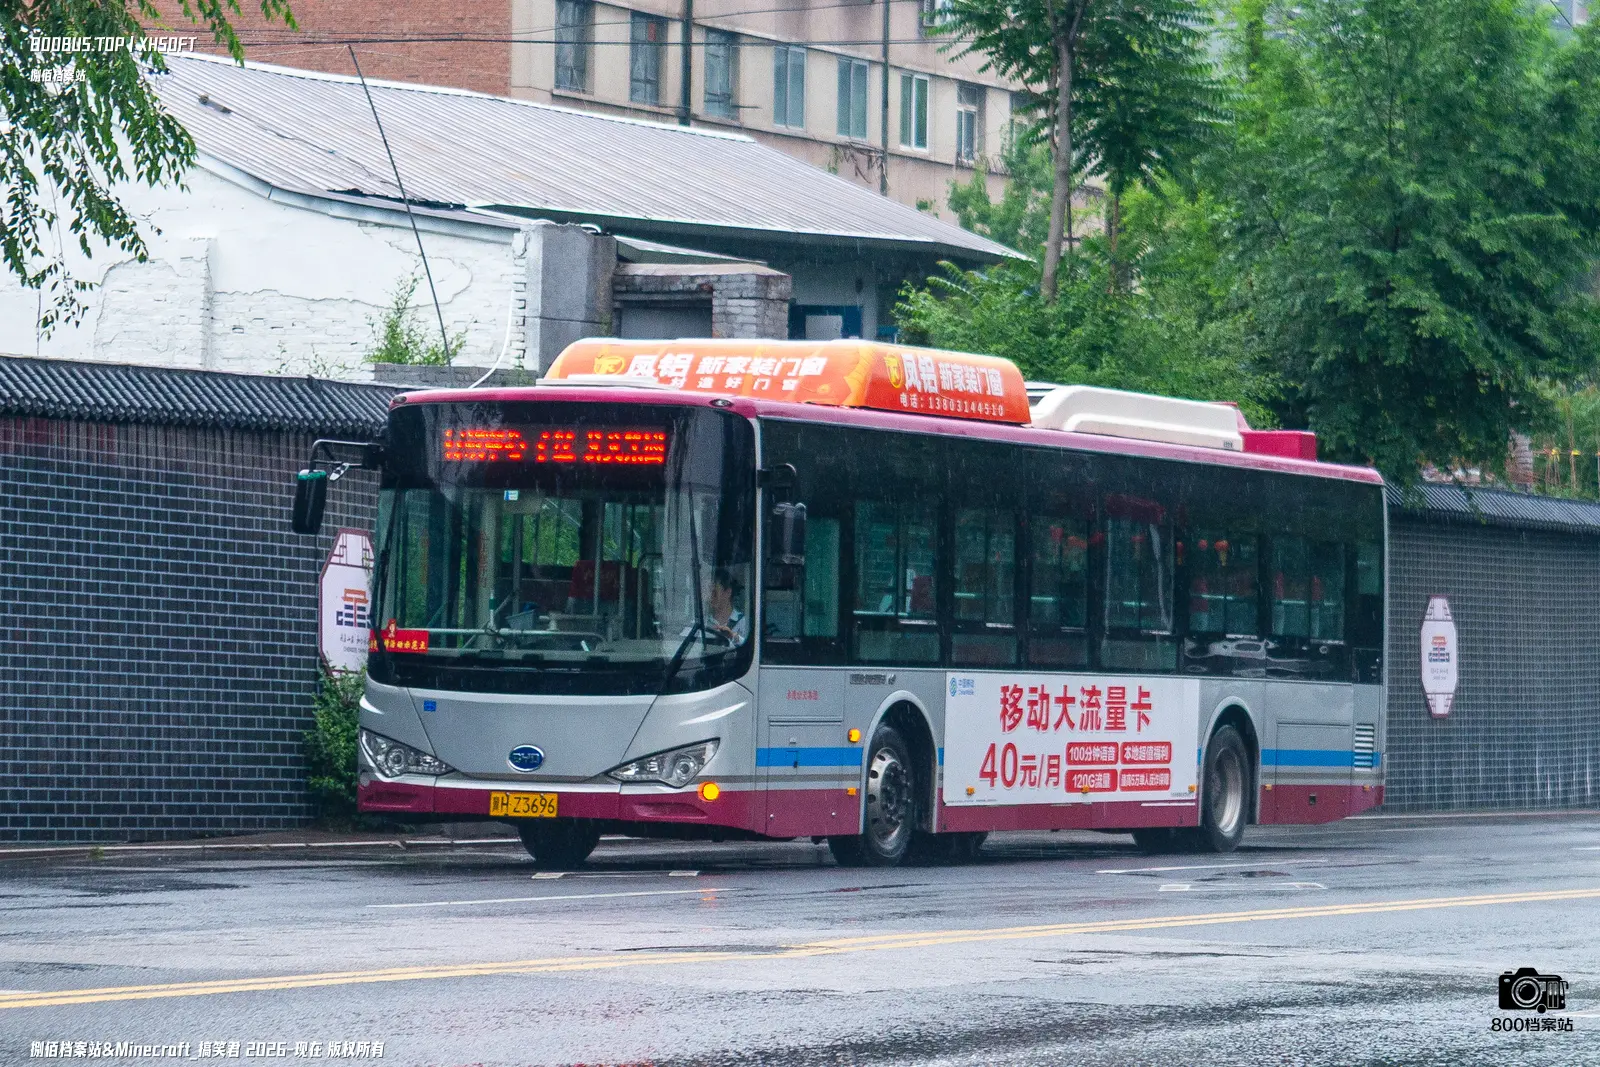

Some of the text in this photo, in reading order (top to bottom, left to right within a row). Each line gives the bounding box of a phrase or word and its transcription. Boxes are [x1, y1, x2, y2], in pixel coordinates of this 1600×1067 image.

[1000, 683, 1152, 733] 移动大流量卡
[979, 742, 1061, 788] 40元/月
[1069, 745, 1116, 762] 100分钟语音
[1072, 772, 1111, 789] 120G流量
